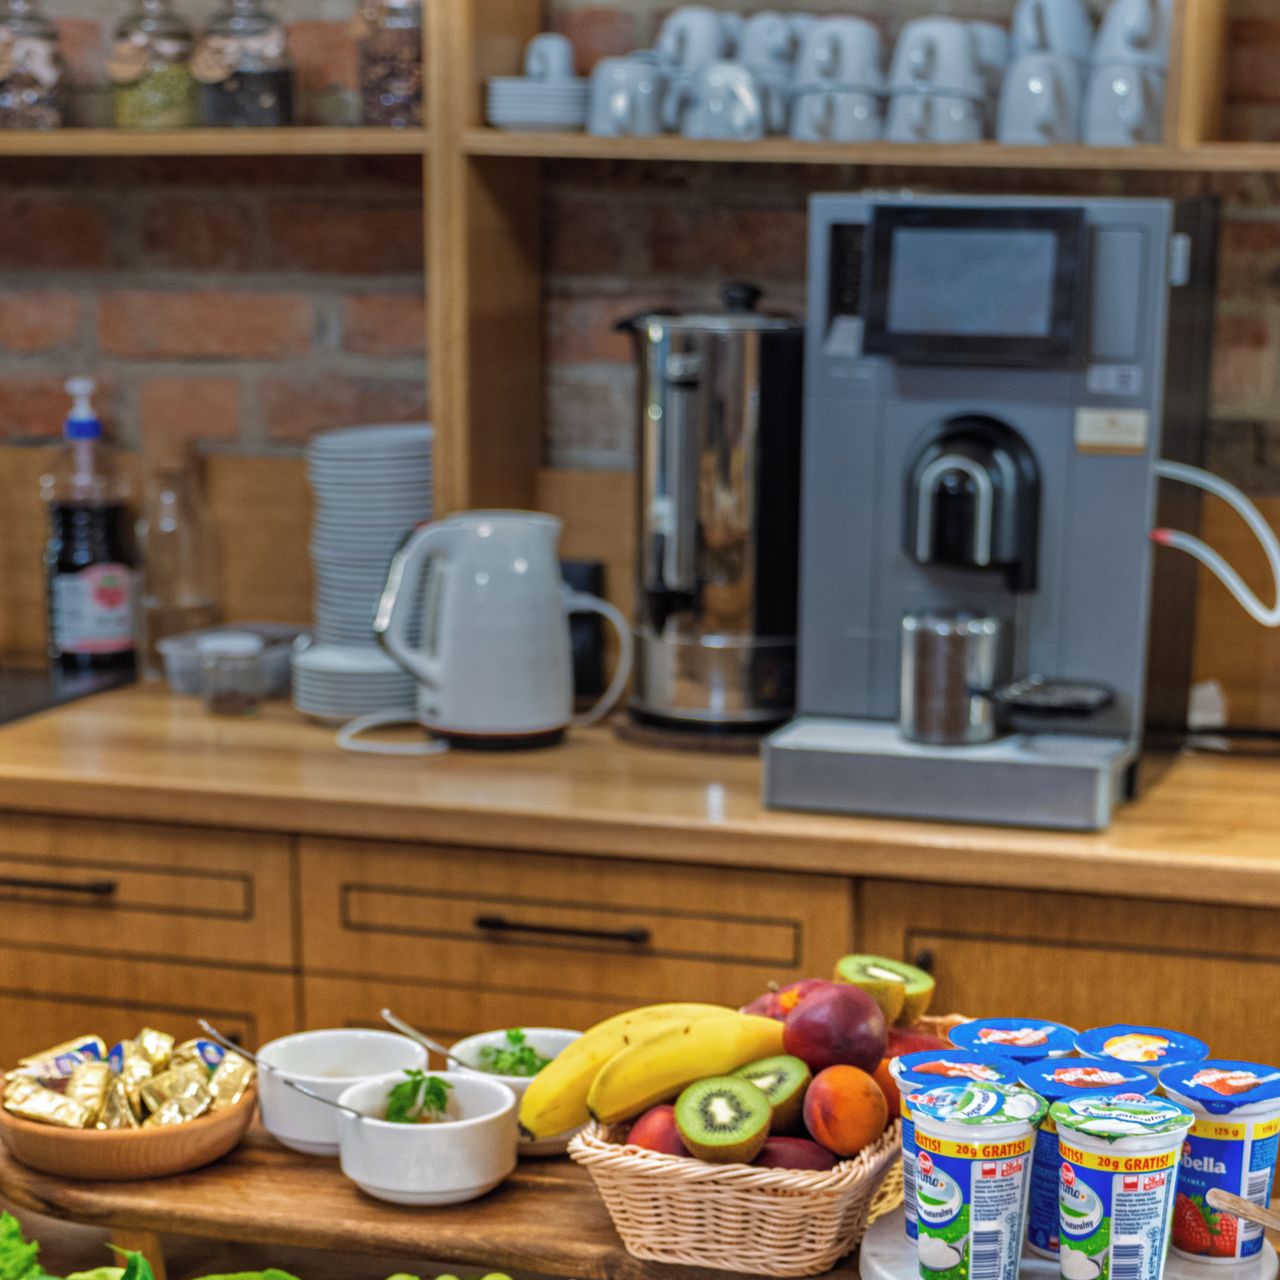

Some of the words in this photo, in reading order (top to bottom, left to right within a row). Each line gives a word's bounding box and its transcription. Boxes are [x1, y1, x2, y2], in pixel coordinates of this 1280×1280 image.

[956, 1144, 969, 1154] 20
[971, 1148, 977, 1158] g
[983, 1141, 1025, 1157] GRATIS!
[1098, 1156, 1111, 1167] 20
[1112, 1160, 1119, 1171] g
[1124, 1154, 1169, 1171] GRATIS!
[1182, 1156, 1227, 1174] bella
